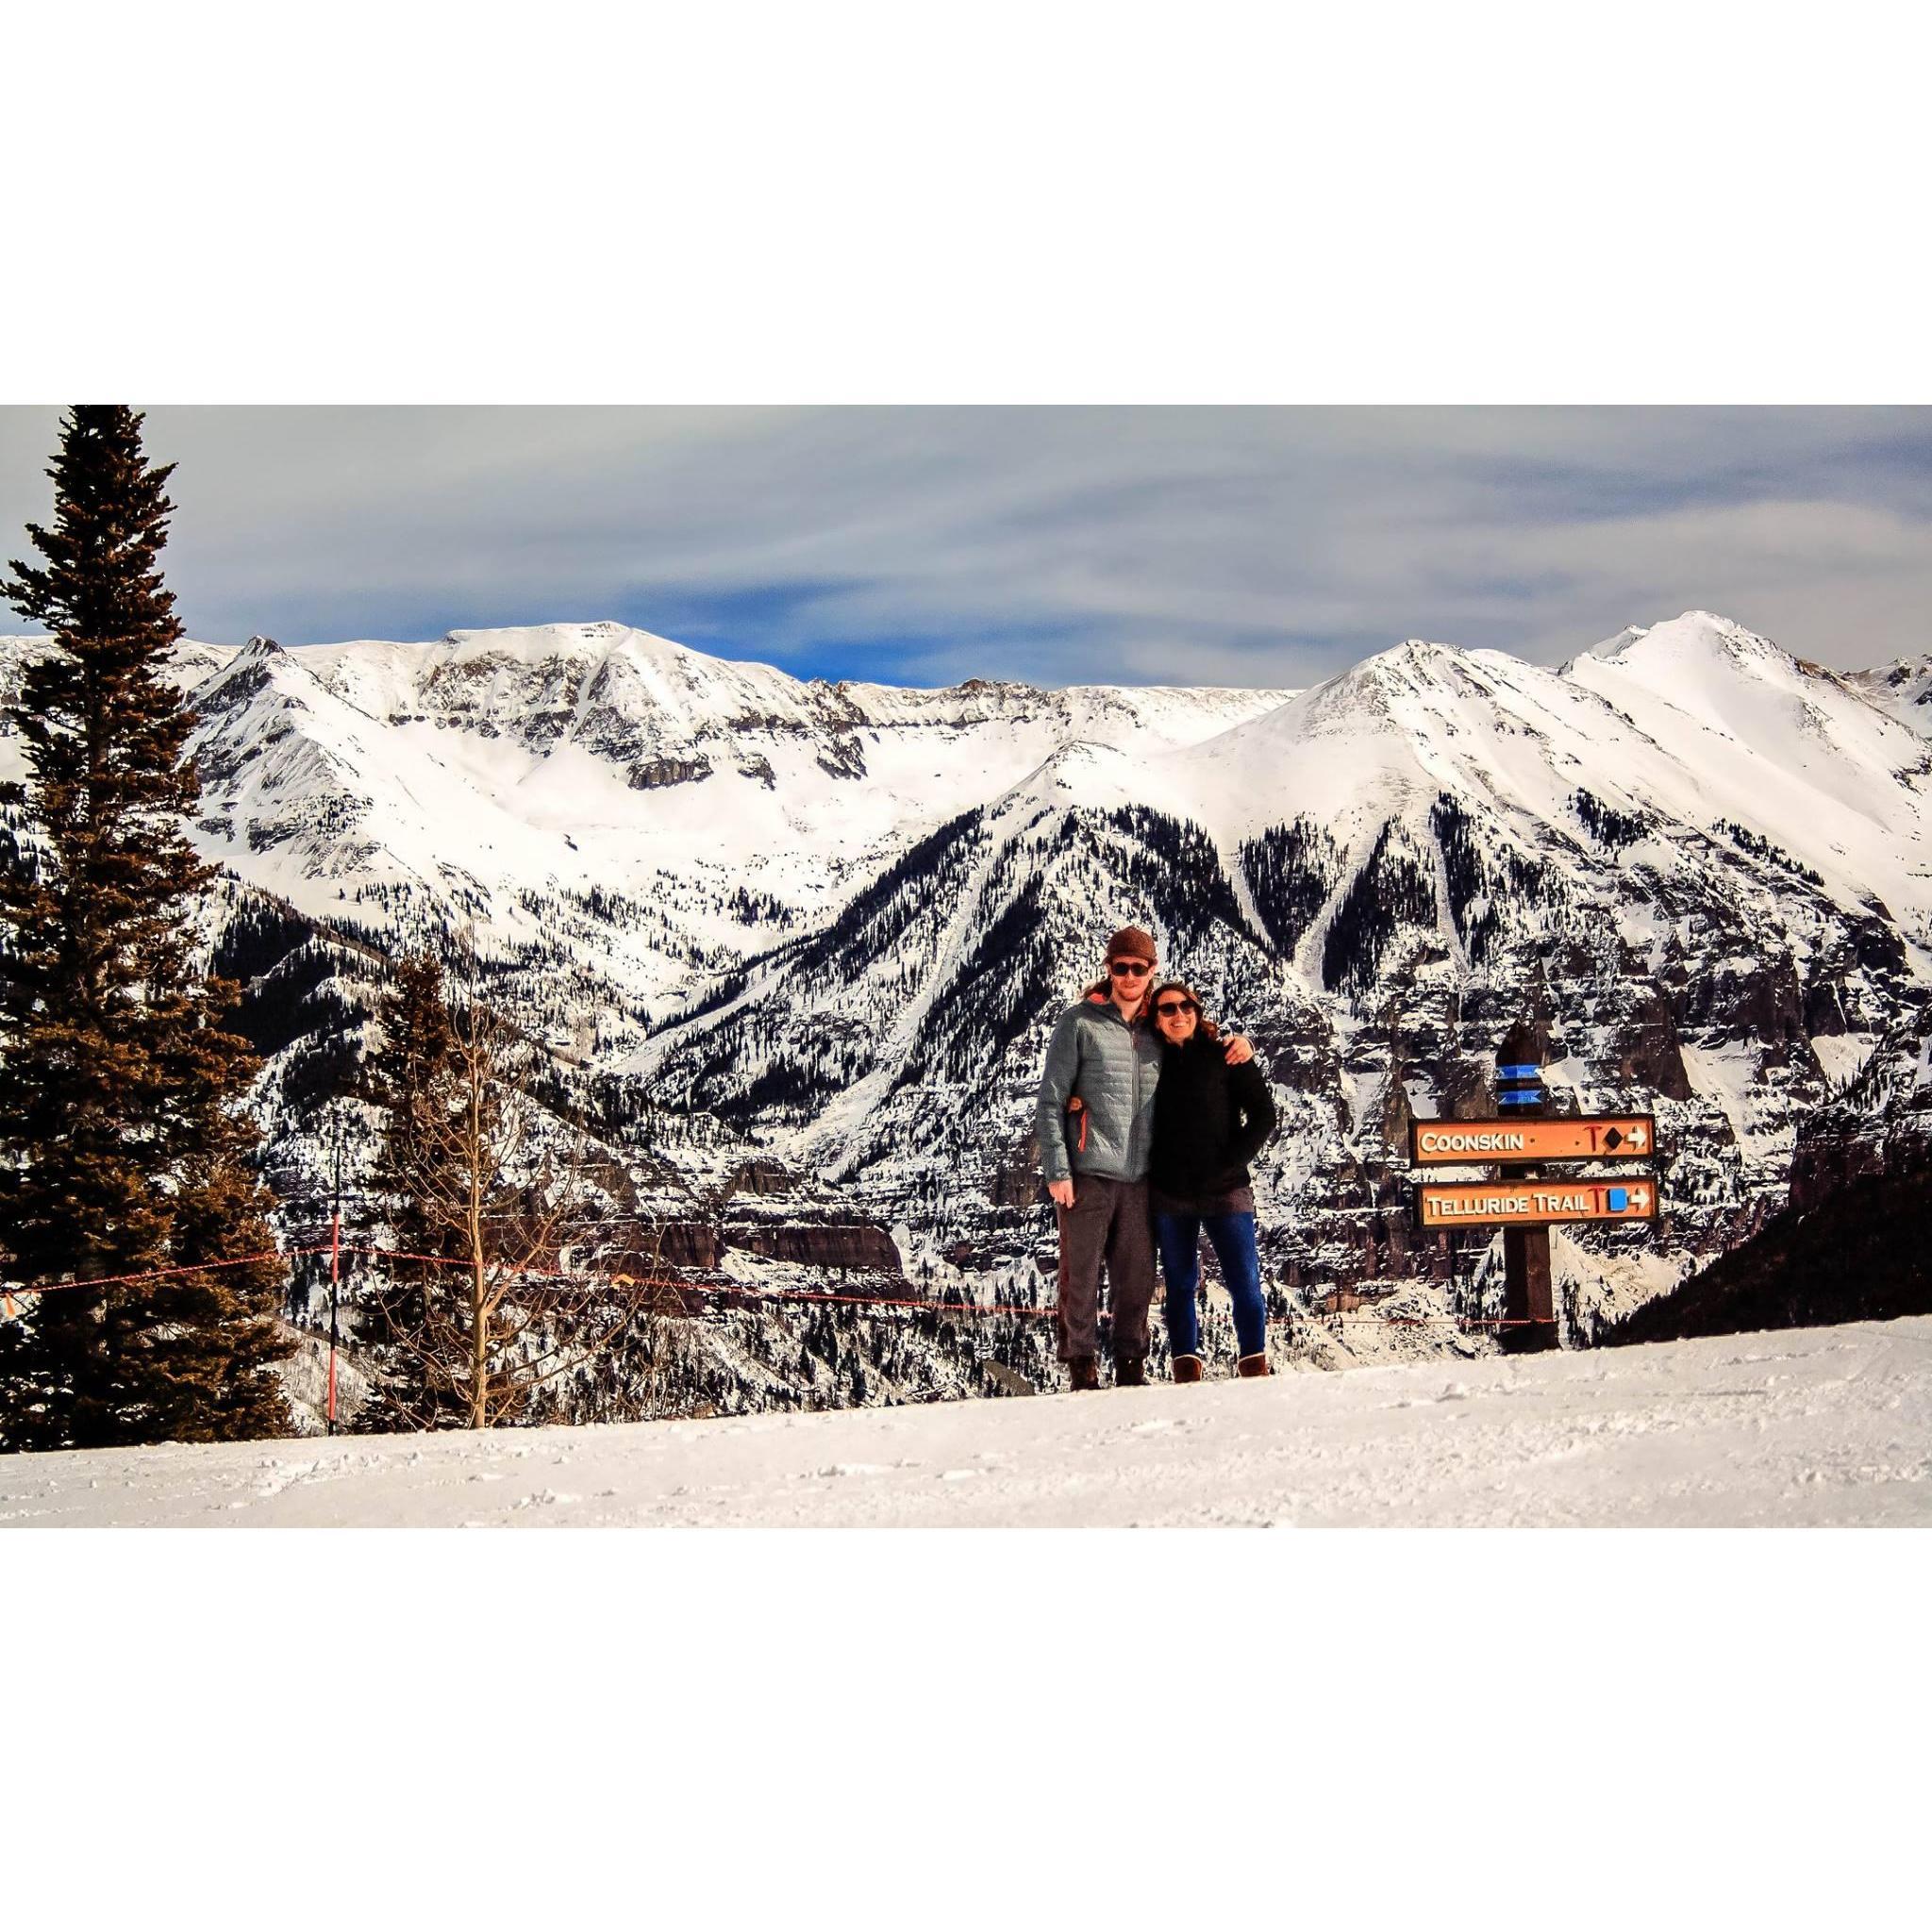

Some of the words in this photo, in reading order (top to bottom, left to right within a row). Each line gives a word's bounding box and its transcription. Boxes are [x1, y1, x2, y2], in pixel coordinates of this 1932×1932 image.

[1420, 1132, 1524, 1152] COONSKIN
[1426, 1196, 1529, 1216] TELLURIDE
[1531, 1192, 1590, 1212] TRAIL
